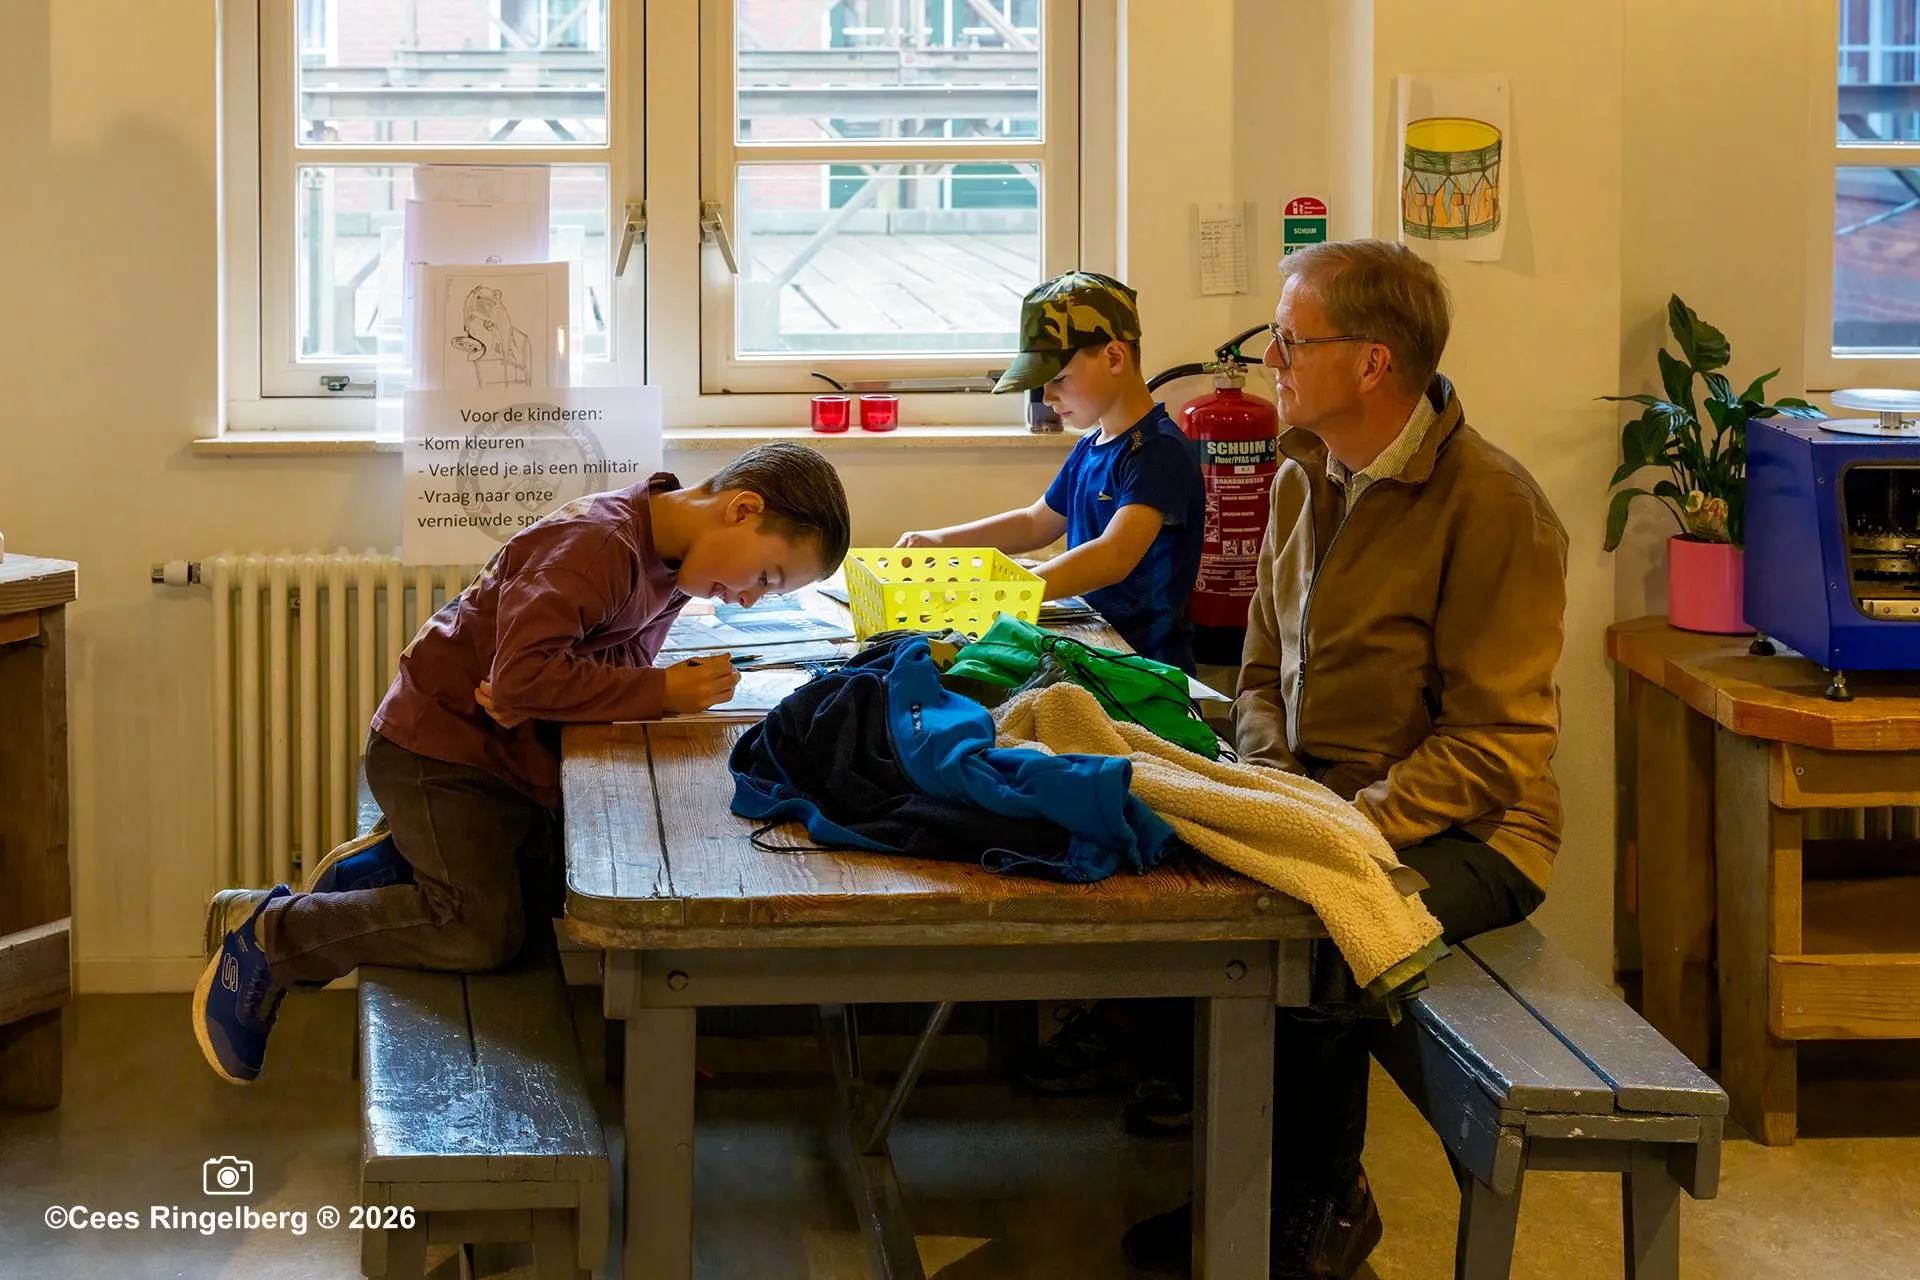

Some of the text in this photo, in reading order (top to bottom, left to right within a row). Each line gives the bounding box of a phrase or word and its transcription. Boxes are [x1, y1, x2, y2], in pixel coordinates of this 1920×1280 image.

[1293, 227, 1317, 235] SCHUIM
[460, 407, 603, 423] Voor de kinderen:
[418, 436, 525, 450] -Kom kleuren
[1207, 440, 1266, 455] SCHUIM
[429, 462, 499, 477] Verkleed
[503, 462, 518, 478] je
[523, 461, 544, 476] als
[548, 463, 578, 475] een
[583, 460, 640, 474] militair
[417, 490, 553, 506] -Vraag naar onze
[417, 512, 513, 528] vernieuwde
